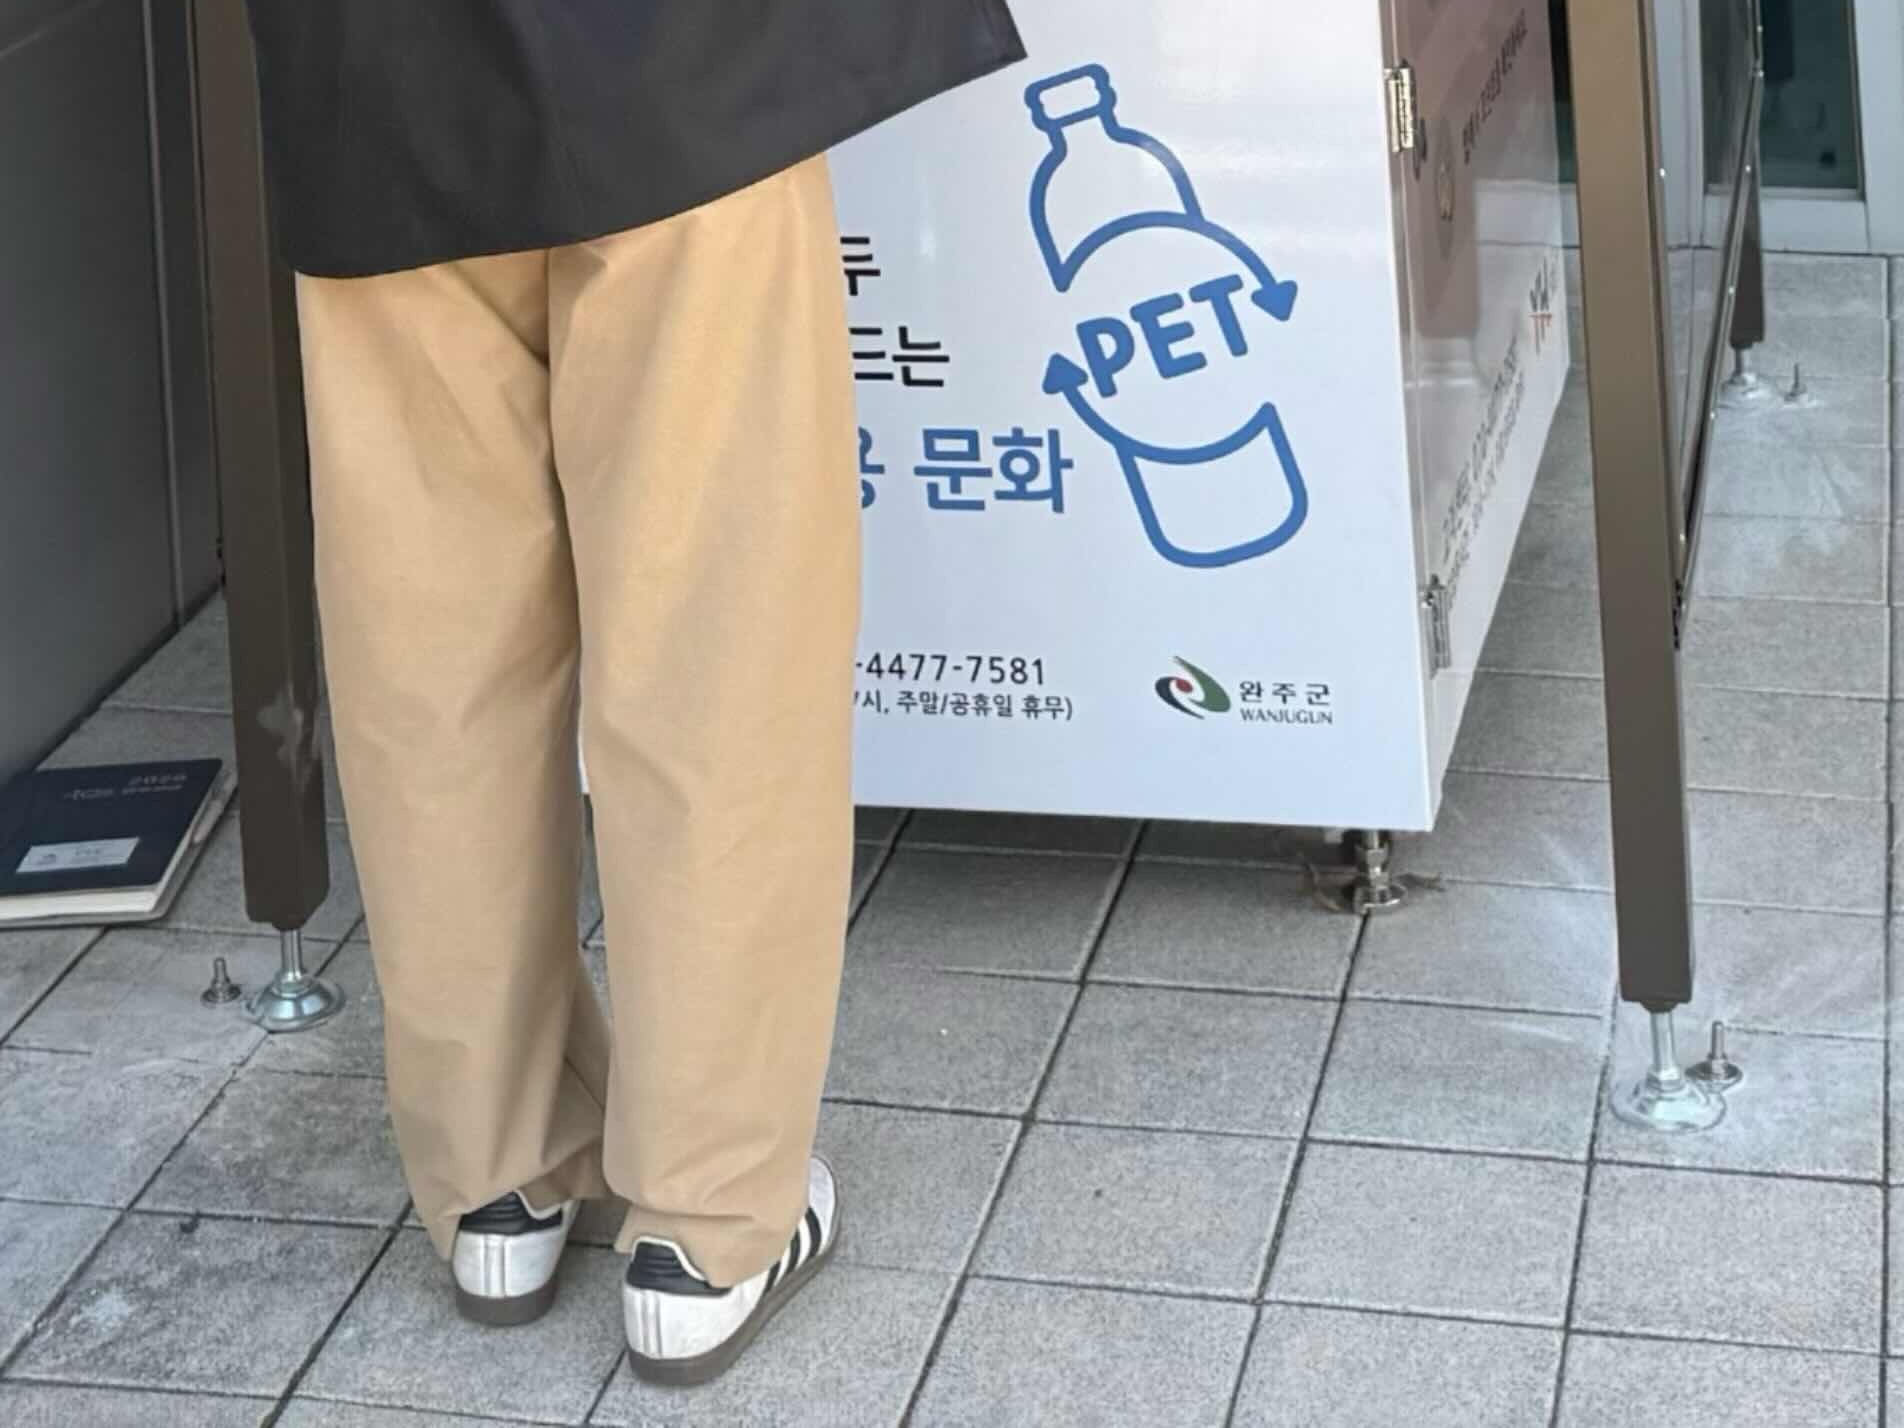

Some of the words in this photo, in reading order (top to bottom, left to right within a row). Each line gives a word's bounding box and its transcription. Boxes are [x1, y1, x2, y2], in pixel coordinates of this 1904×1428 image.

[840, 237, 881, 296] 두
[849, 326, 950, 387] 드는
[1076, 273, 1249, 399] PET
[913, 426, 1074, 514] 문화
[897, 690, 1013, 719] 주말/공휴일
[1021, 694, 1073, 722] 휴무)
[1239, 680, 1331, 706] 완주군
[1240, 707, 1334, 725] WANJUGUN
